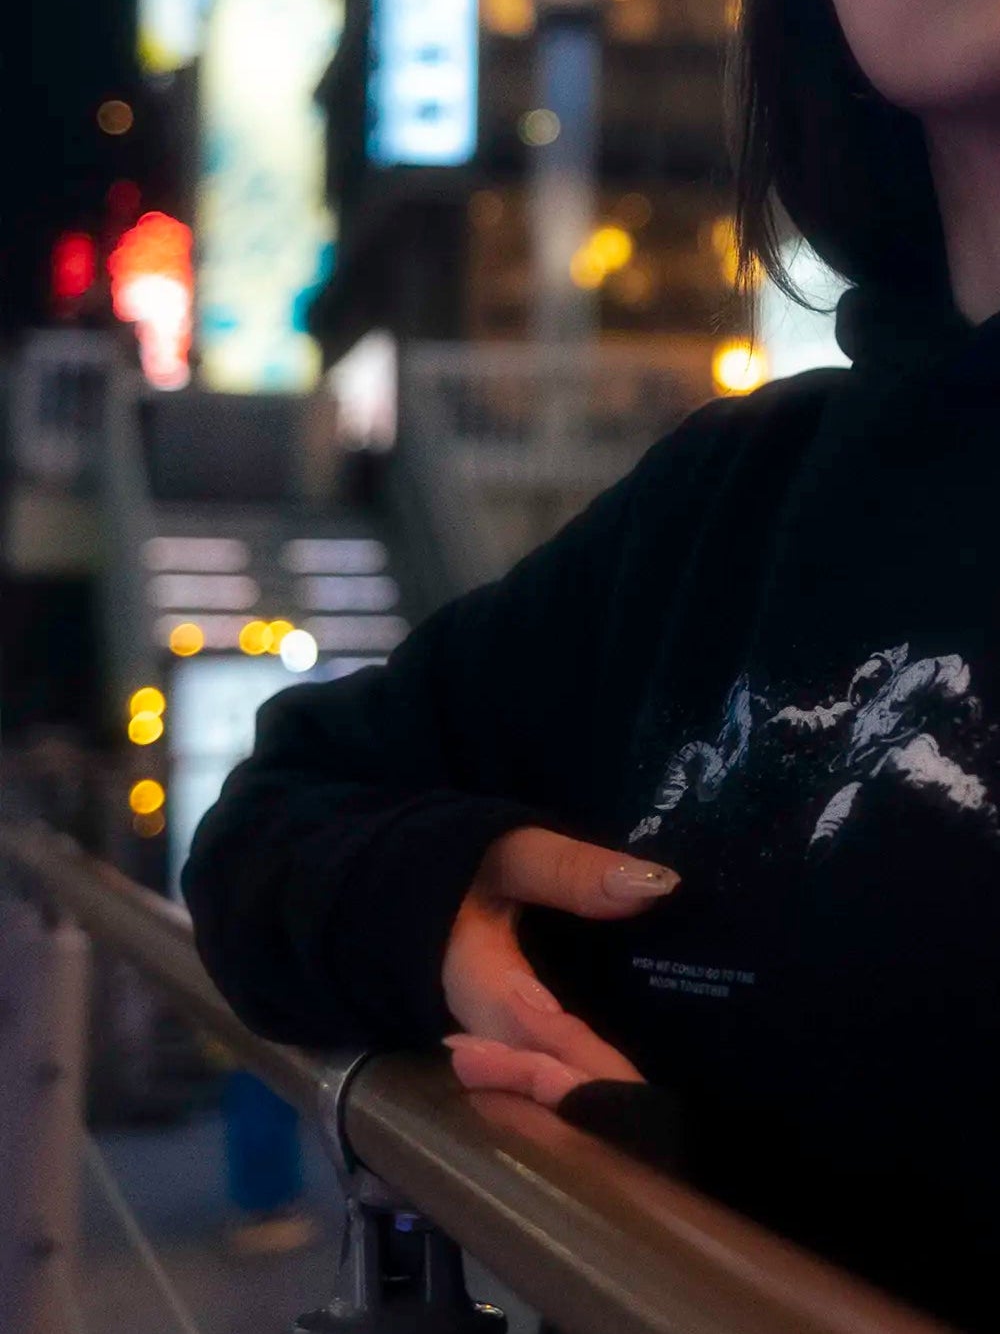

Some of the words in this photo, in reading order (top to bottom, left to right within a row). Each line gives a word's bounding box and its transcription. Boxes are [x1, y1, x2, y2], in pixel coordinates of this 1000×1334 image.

[656, 960, 671, 972] WE
[672, 963, 705, 977] COULD
[705, 968, 720, 980] GO
[721, 969, 735, 982] TO
[680, 979, 729, 997] TOGETHER
